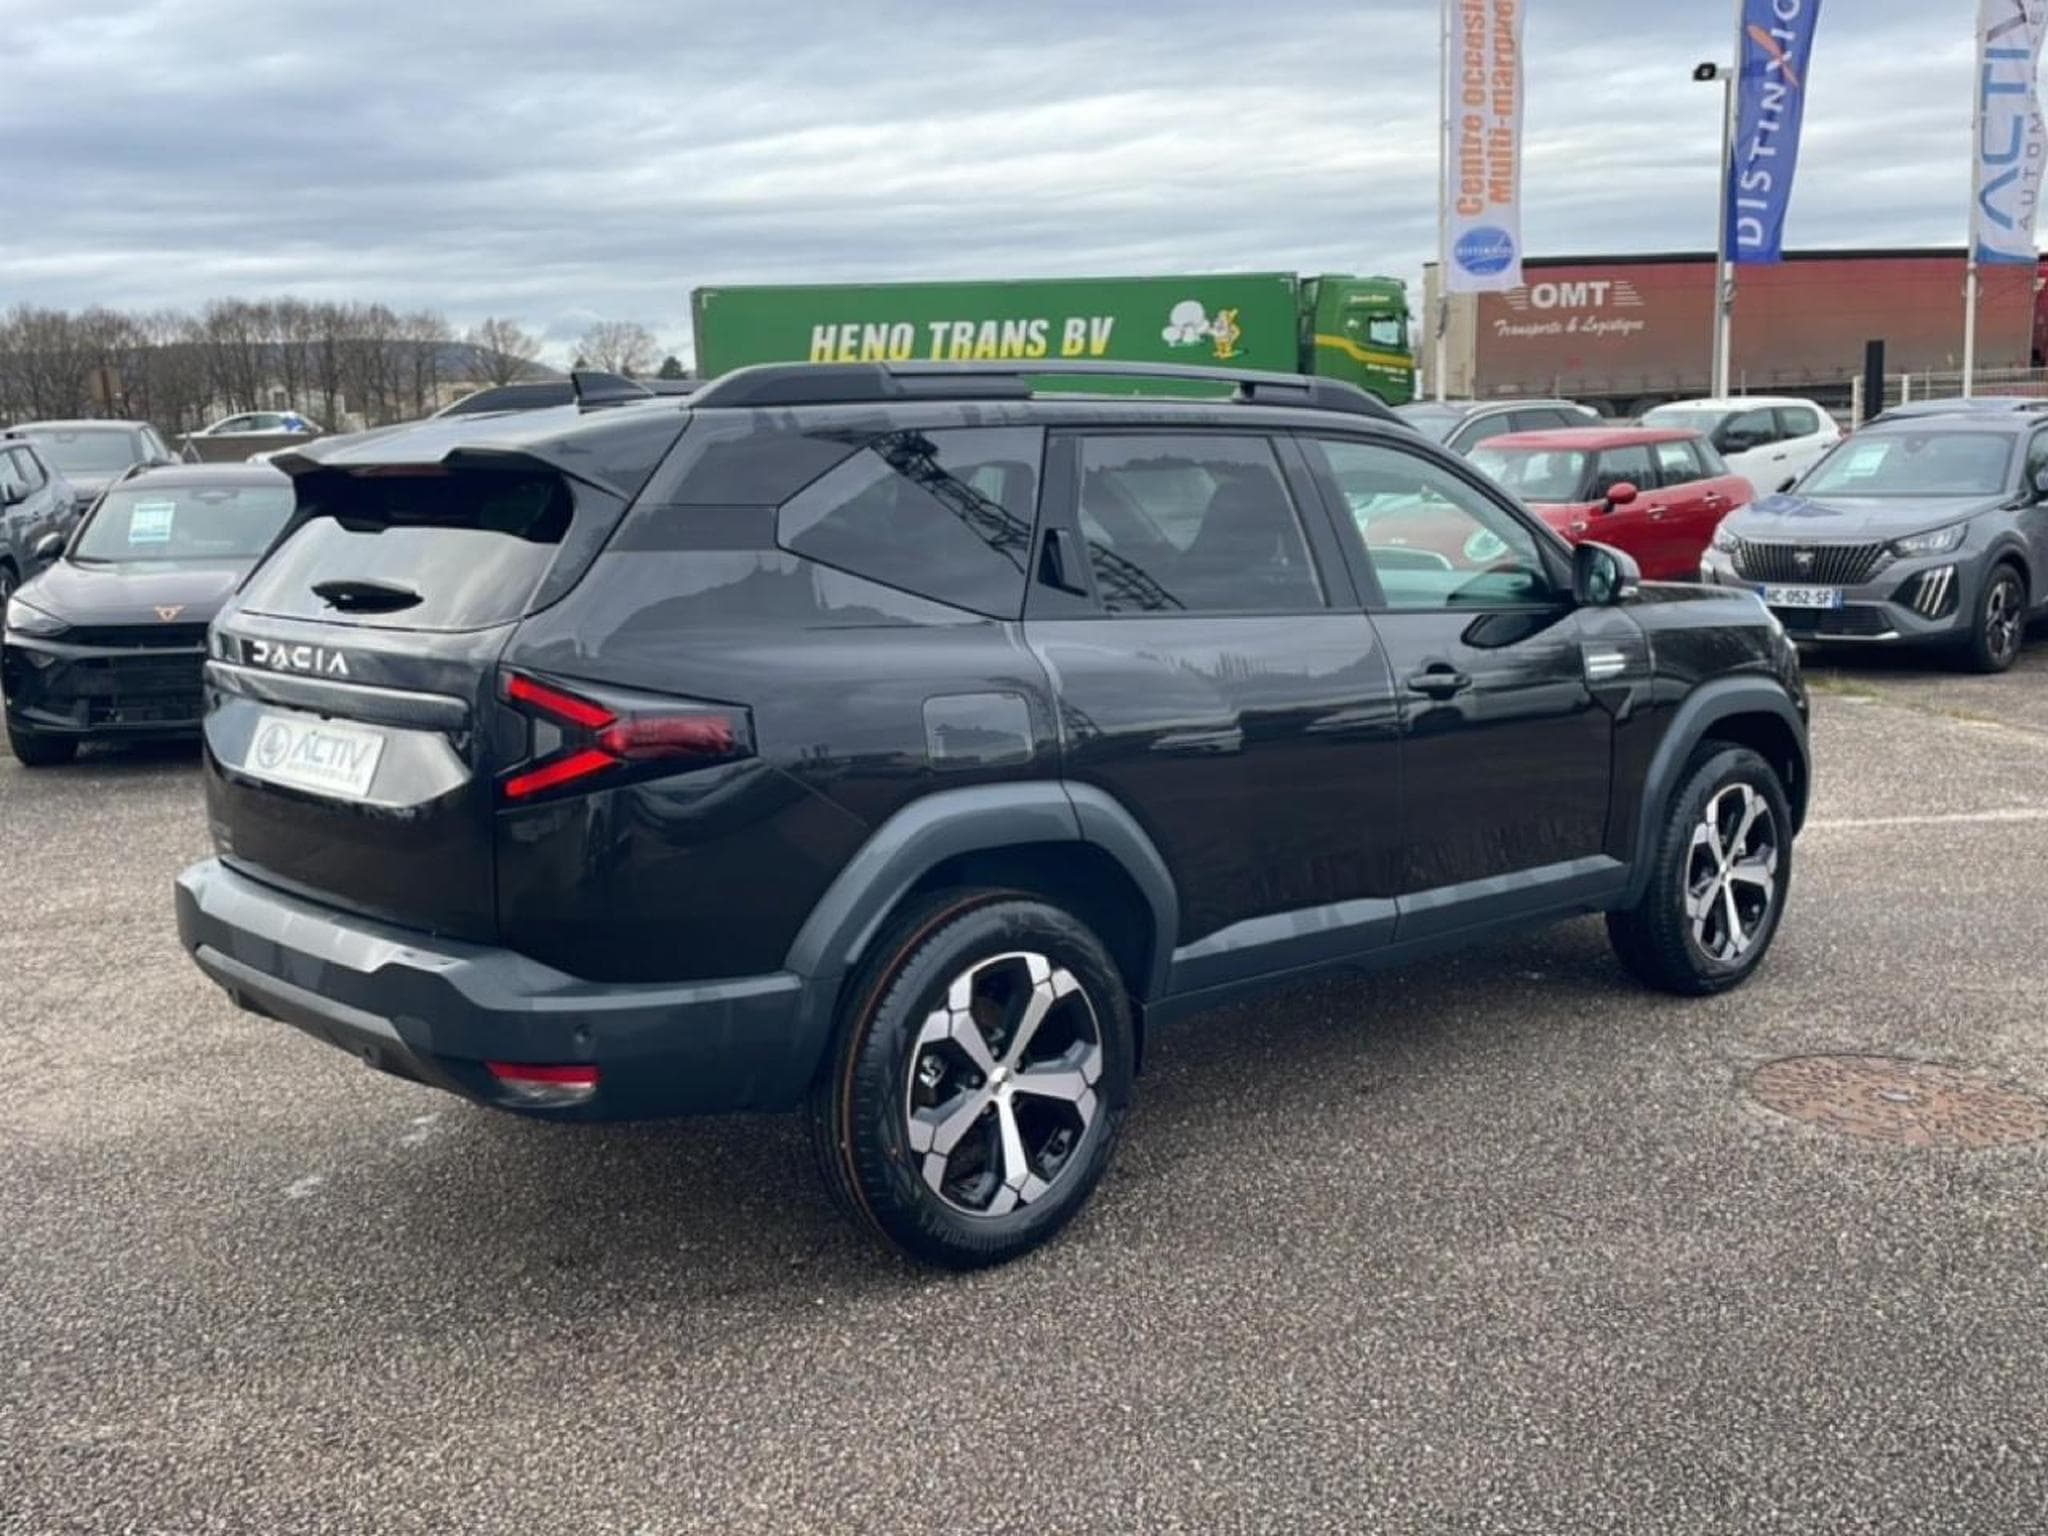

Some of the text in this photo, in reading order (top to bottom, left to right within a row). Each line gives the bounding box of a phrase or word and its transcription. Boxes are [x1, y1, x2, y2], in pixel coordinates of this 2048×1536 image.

[1457, 113, 1485, 216] Centre
[1530, 280, 1611, 309] OMT
[809, 316, 1115, 363] HENO TRANS BV
[252, 640, 350, 675] DACIA
[290, 732, 374, 770] ACTIV
